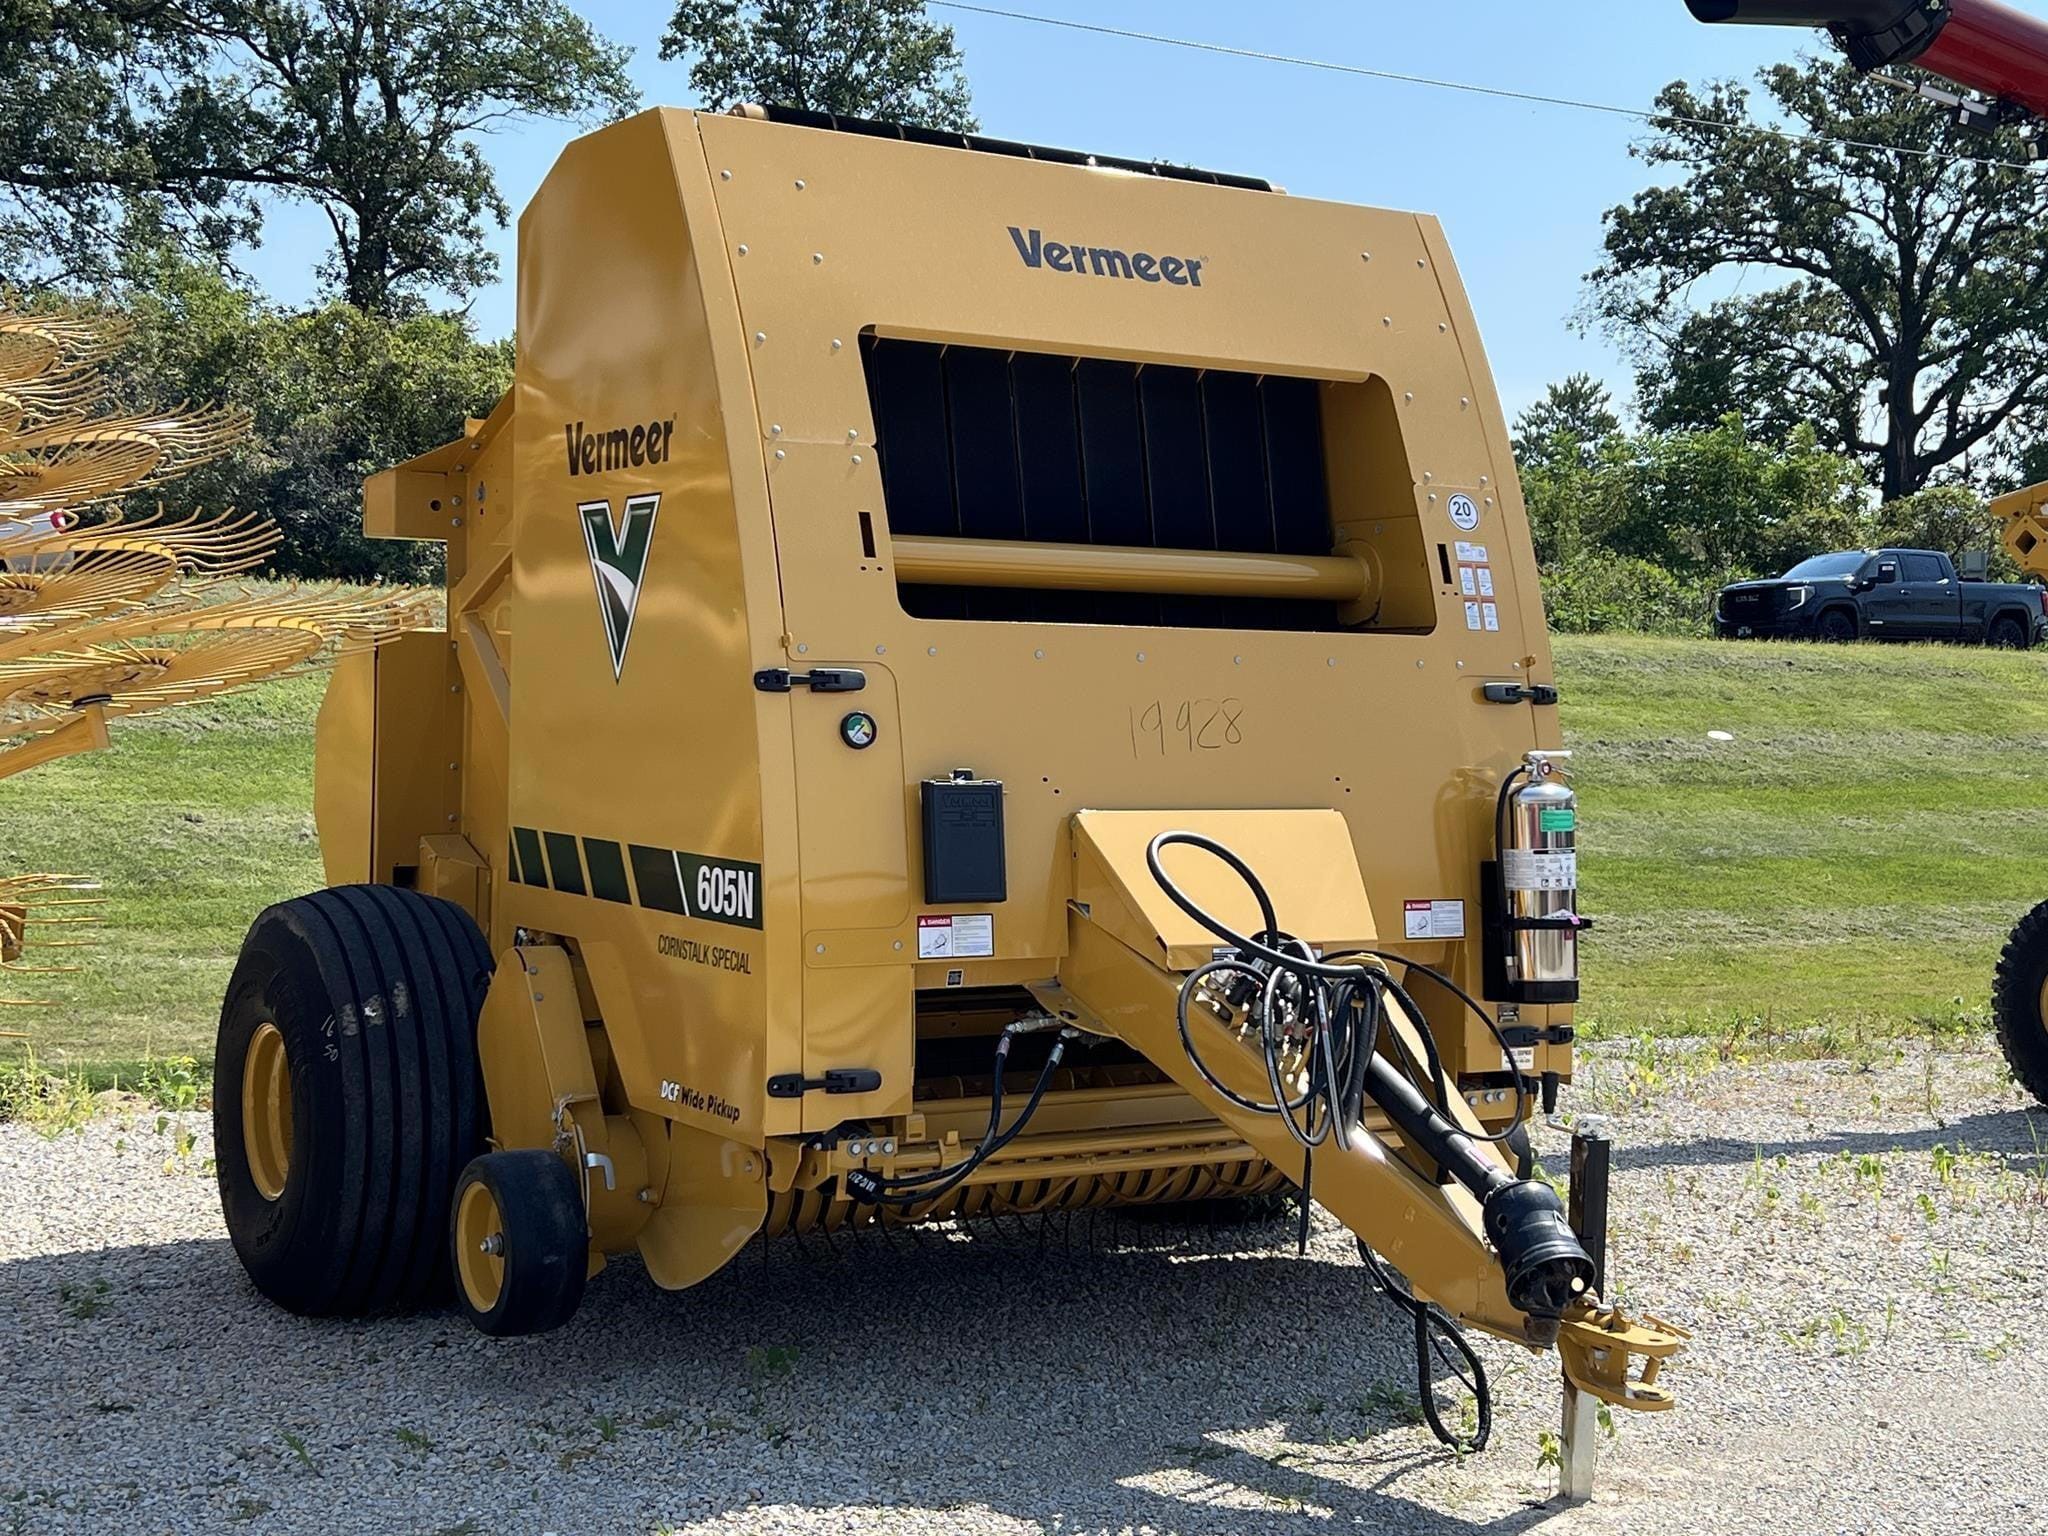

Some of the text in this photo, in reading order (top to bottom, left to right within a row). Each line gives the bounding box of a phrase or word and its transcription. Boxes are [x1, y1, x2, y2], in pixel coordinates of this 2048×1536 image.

[1007, 226, 1202, 287] Vermeer
[565, 419, 674, 476] Vermeer
[1452, 501, 1471, 517] 20
[1129, 697, 1244, 760] 19928
[697, 864, 754, 919] 605N
[657, 933, 752, 975] CORNSTALK SPECIAL
[660, 1079, 740, 1125] DCF Wide Pickup
